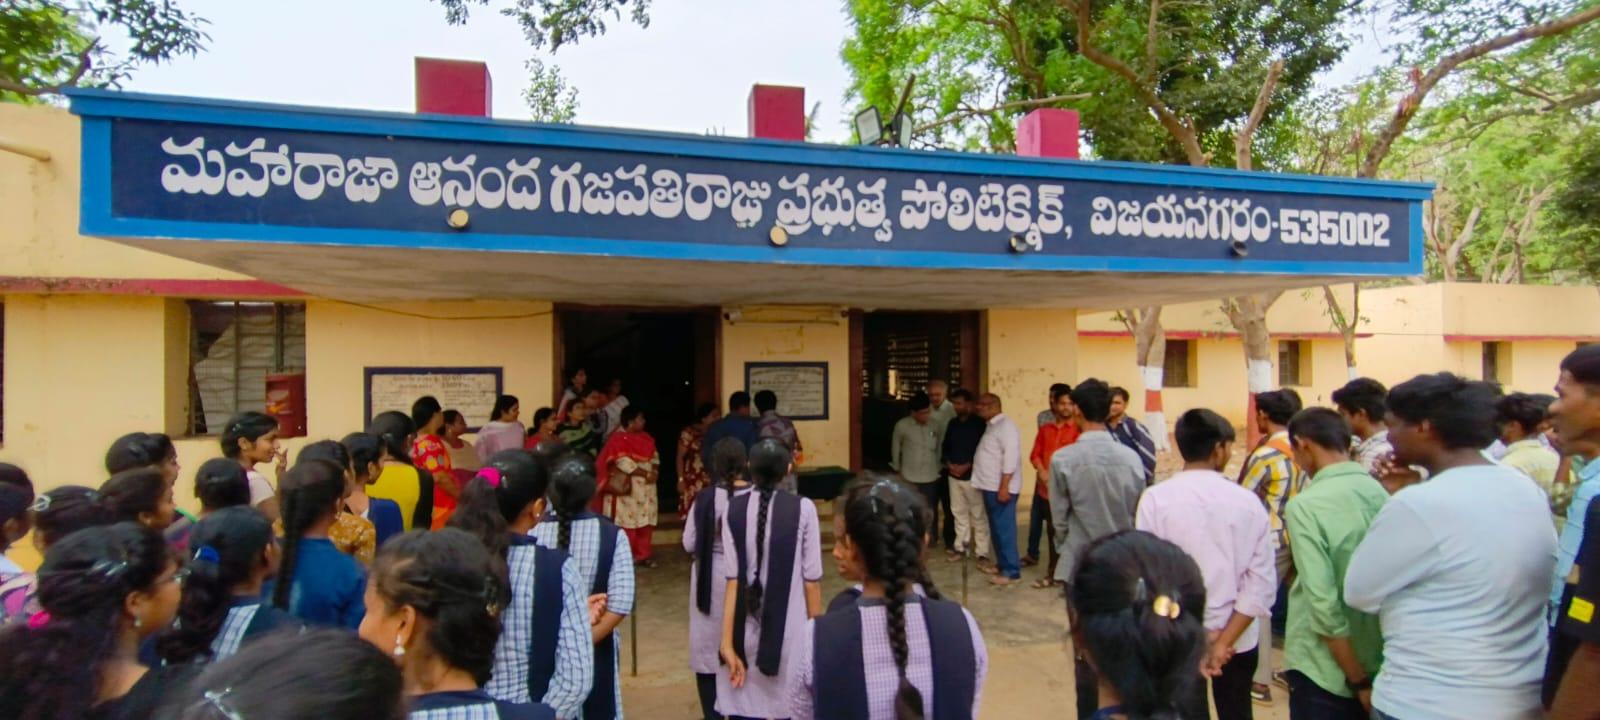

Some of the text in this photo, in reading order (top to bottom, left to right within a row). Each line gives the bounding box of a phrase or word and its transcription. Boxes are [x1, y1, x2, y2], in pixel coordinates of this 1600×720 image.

[160, 136, 400, 203] మహారాజా
[408, 153, 542, 211] ఆనంద
[776, 172, 894, 242] ప్రభుత్వ
